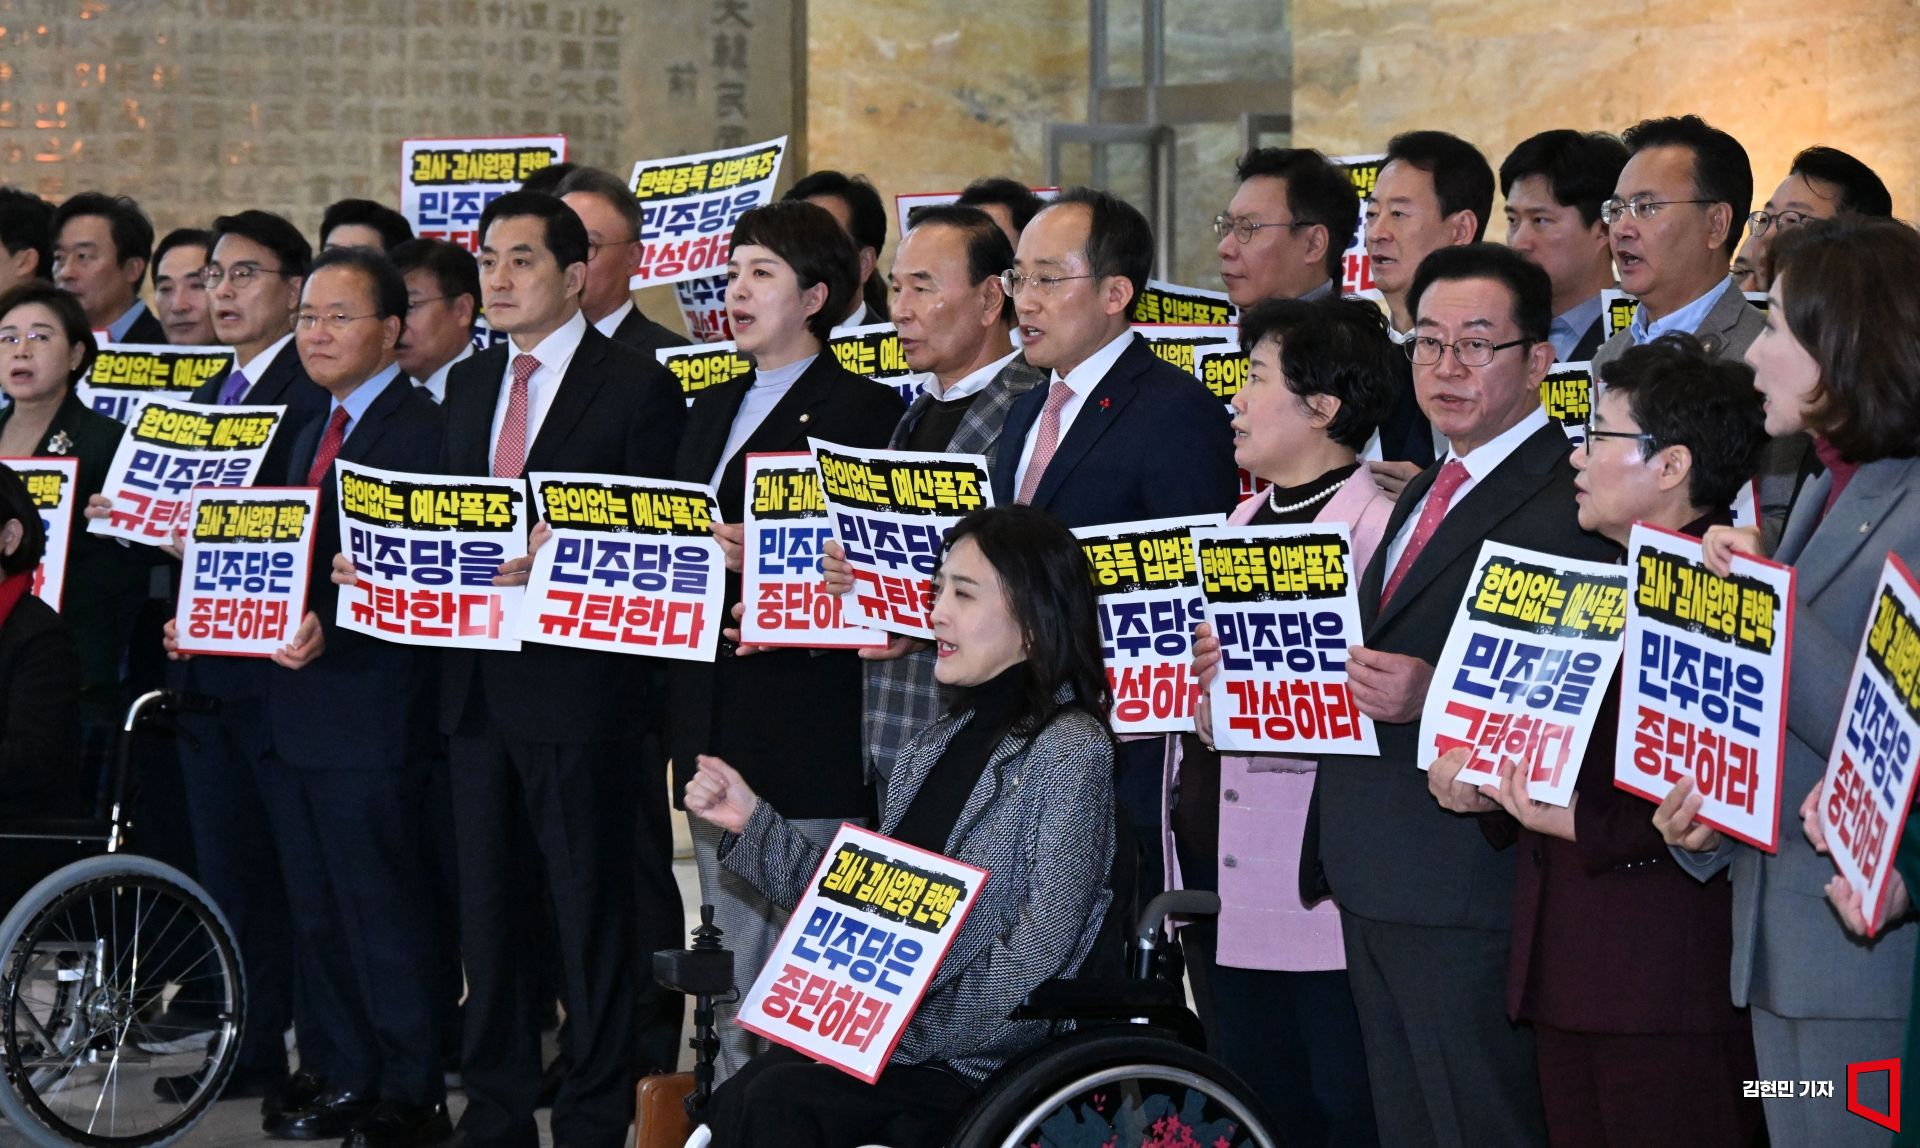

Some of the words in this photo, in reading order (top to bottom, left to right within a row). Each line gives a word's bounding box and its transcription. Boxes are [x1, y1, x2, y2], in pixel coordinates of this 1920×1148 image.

[414, 153, 515, 181] 검사·감사원장
[636, 164, 709, 198] 탄핵중독
[709, 150, 776, 190] 입법폭주
[91, 353, 170, 387] 합의없는
[137, 407, 214, 446] 합의없는
[212, 417, 274, 446] 예산폭주
[27, 474, 61, 506] 탄핵
[343, 474, 405, 523] 합의없는
[410, 489, 511, 528] 예산폭주
[545, 485, 628, 526] 합의없는
[631, 492, 713, 533] 예산폭주
[820, 453, 891, 505] 합의없는
[891, 467, 982, 512] 예산폭주
[196, 504, 277, 538] 검사·감사원장
[275, 505, 306, 539] 탄핵
[836, 512, 952, 575] 민주당
[194, 550, 294, 593] 민주당은
[350, 526, 505, 587] 민주당을
[549, 537, 710, 596] 민주당을
[1201, 546, 1269, 593] 탄핵중독
[1268, 543, 1345, 593] 입법폭주
[188, 597, 289, 641] 중단하라
[351, 578, 504, 640] 규탄한다
[538, 589, 705, 649] 규탄한다
[756, 580, 869, 630] 중단하
[1474, 563, 1567, 626] 합의없는
[1560, 581, 1628, 635] 예산폭주
[1638, 554, 1738, 635] 검사·감사원장
[1738, 588, 1774, 649] 탄핵
[1214, 611, 1348, 673] 민주당은
[1452, 632, 1602, 716] 민주당을
[1638, 629, 1764, 738] 민주당은
[1226, 679, 1363, 741] 각성하라
[1846, 672, 1911, 809] 민주당은
[1434, 700, 1575, 788] 규탄한다
[1633, 704, 1759, 815] 중단하라
[1826, 749, 1888, 888] 중단하라
[823, 850, 924, 917] 검사·감사원장
[913, 882, 960, 929] 탄핵
[791, 906, 923, 996] 민주당은
[761, 963, 892, 1054] 중단하라
